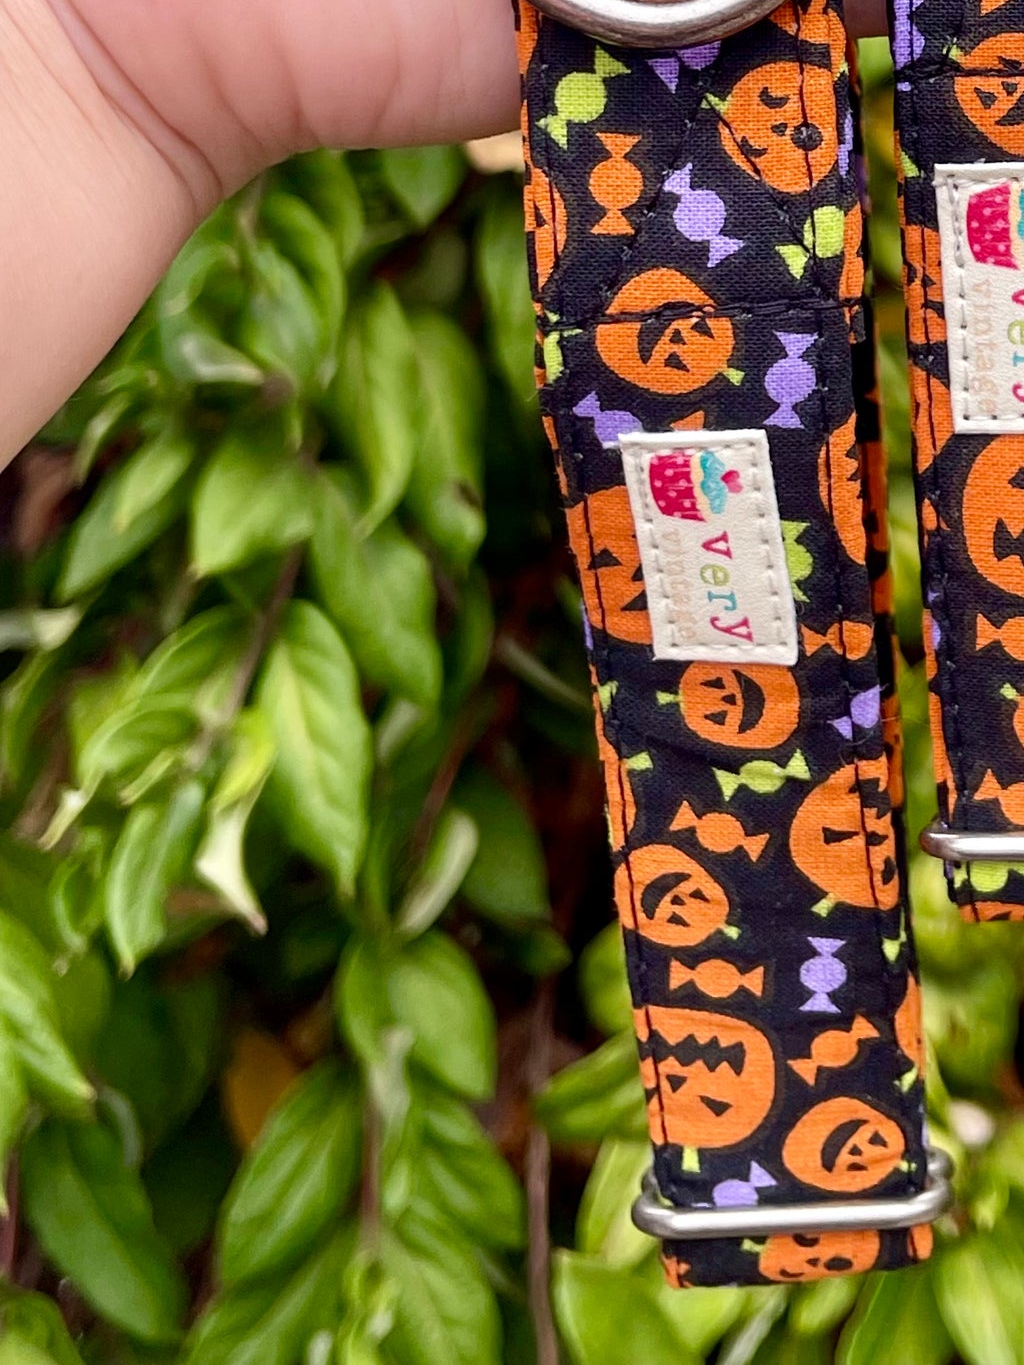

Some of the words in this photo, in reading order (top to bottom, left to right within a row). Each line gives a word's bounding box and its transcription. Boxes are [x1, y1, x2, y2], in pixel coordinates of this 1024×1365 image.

[971, 278, 999, 414] vintage
[662, 527, 698, 641] vintage
[700, 530, 754, 643] very
